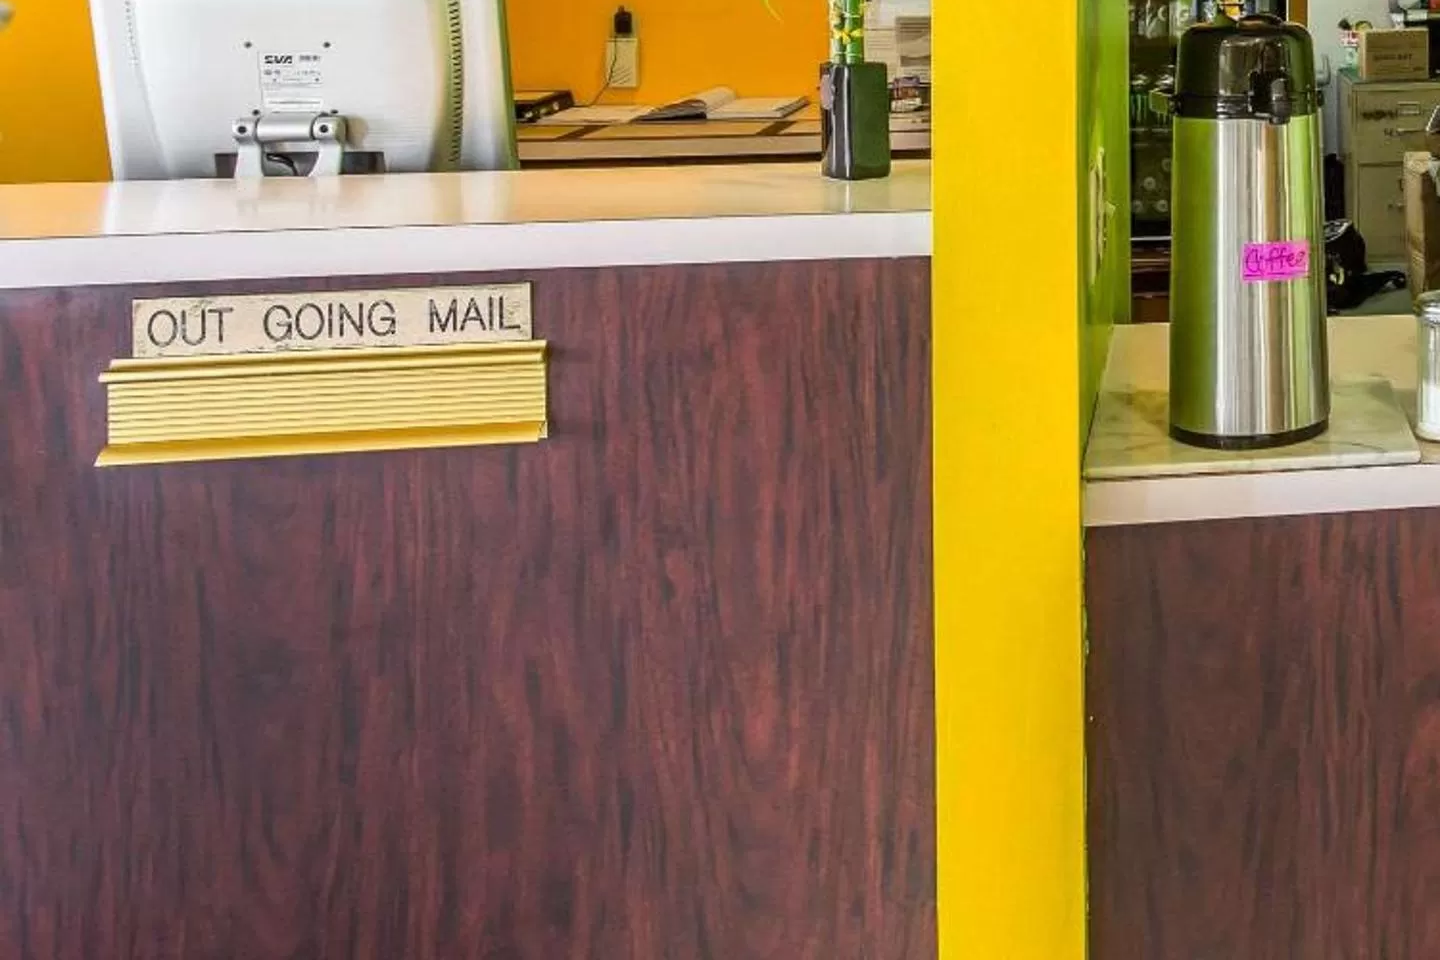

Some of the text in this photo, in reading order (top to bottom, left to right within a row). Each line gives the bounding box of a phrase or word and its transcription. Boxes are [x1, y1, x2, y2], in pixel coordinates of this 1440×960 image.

[147, 295, 521, 347] OUT GOING MAIL
